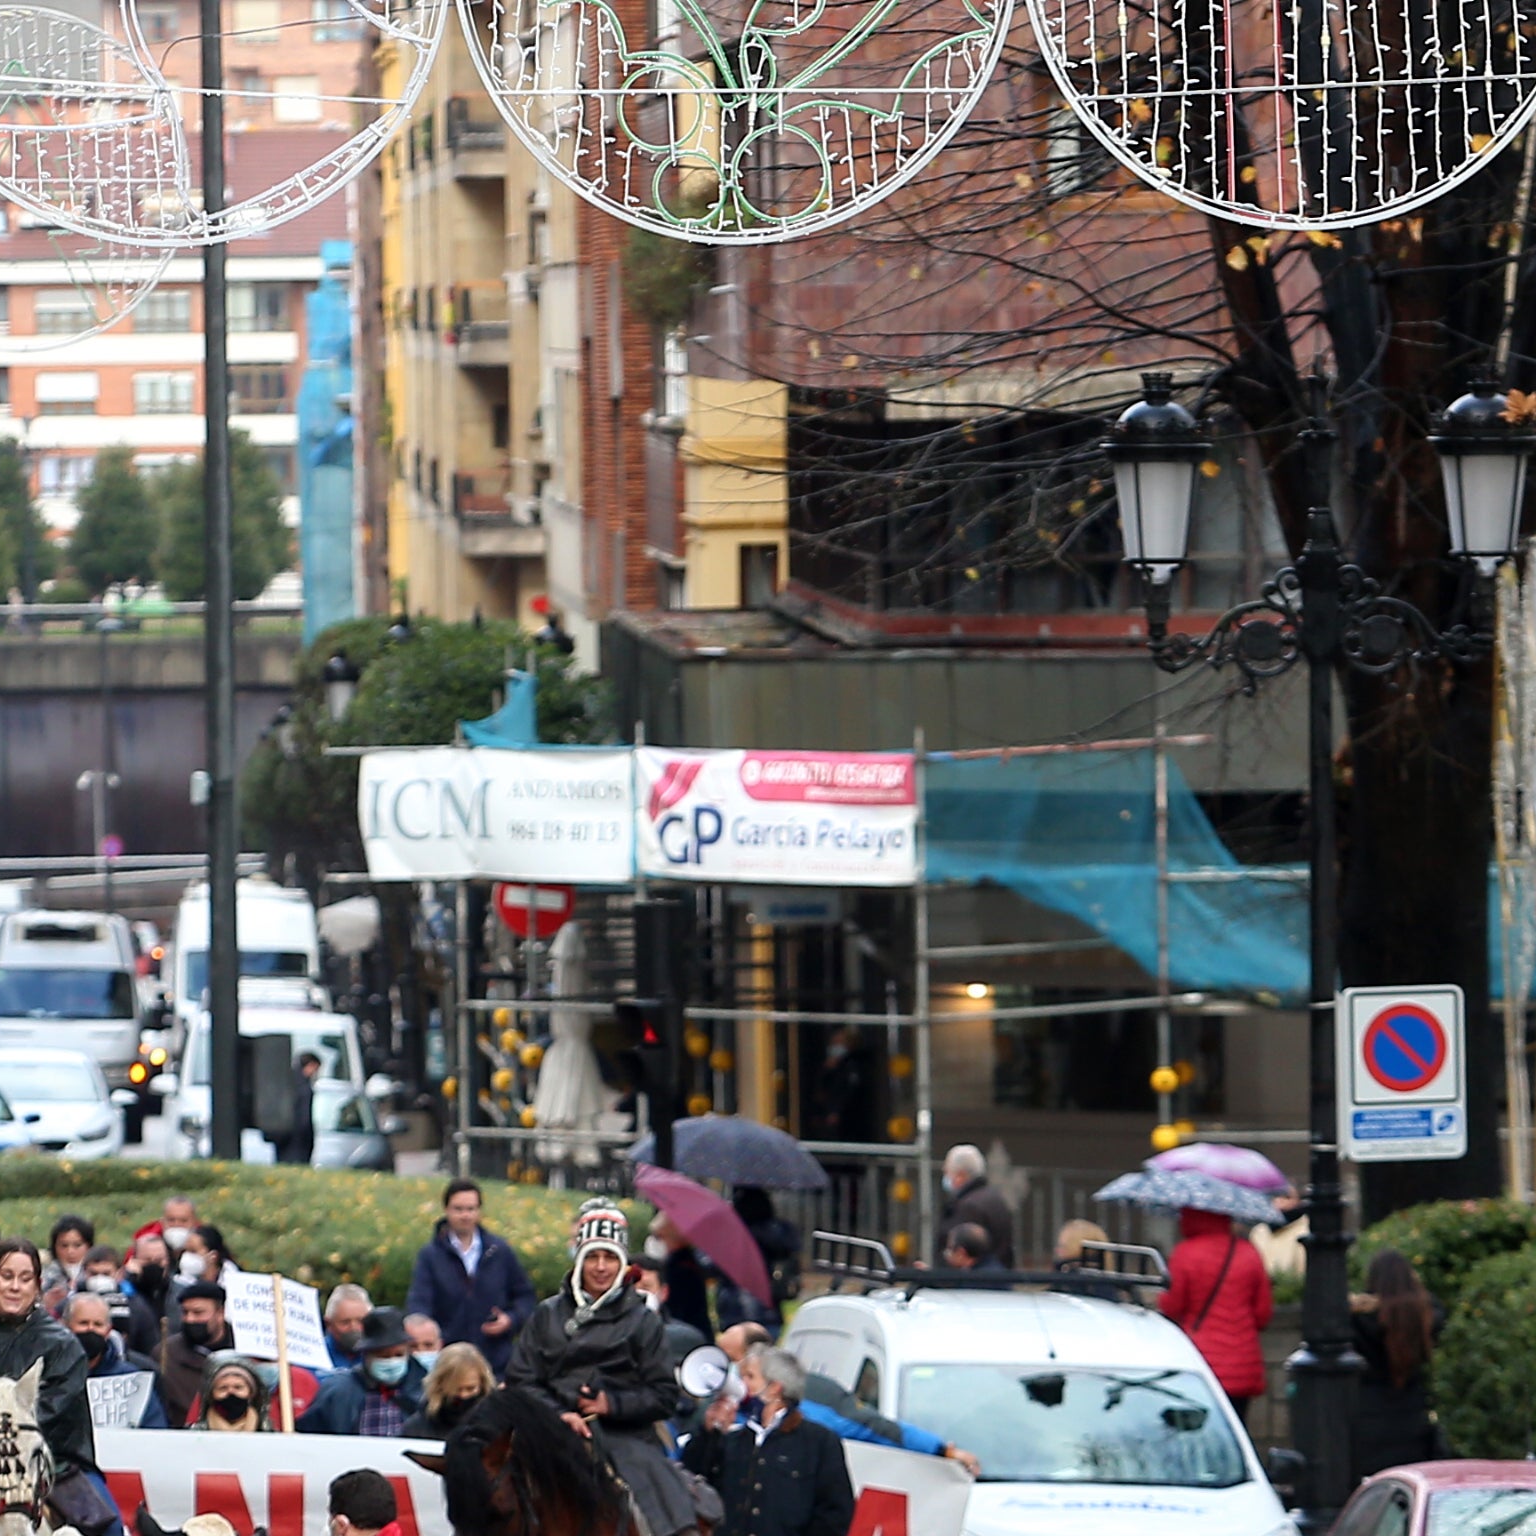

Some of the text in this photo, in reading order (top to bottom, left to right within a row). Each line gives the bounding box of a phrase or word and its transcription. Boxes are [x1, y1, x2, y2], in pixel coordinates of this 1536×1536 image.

[367, 778, 493, 840] ICM
[660, 807, 723, 865] GP
[731, 815, 906, 857] García Pelayo
